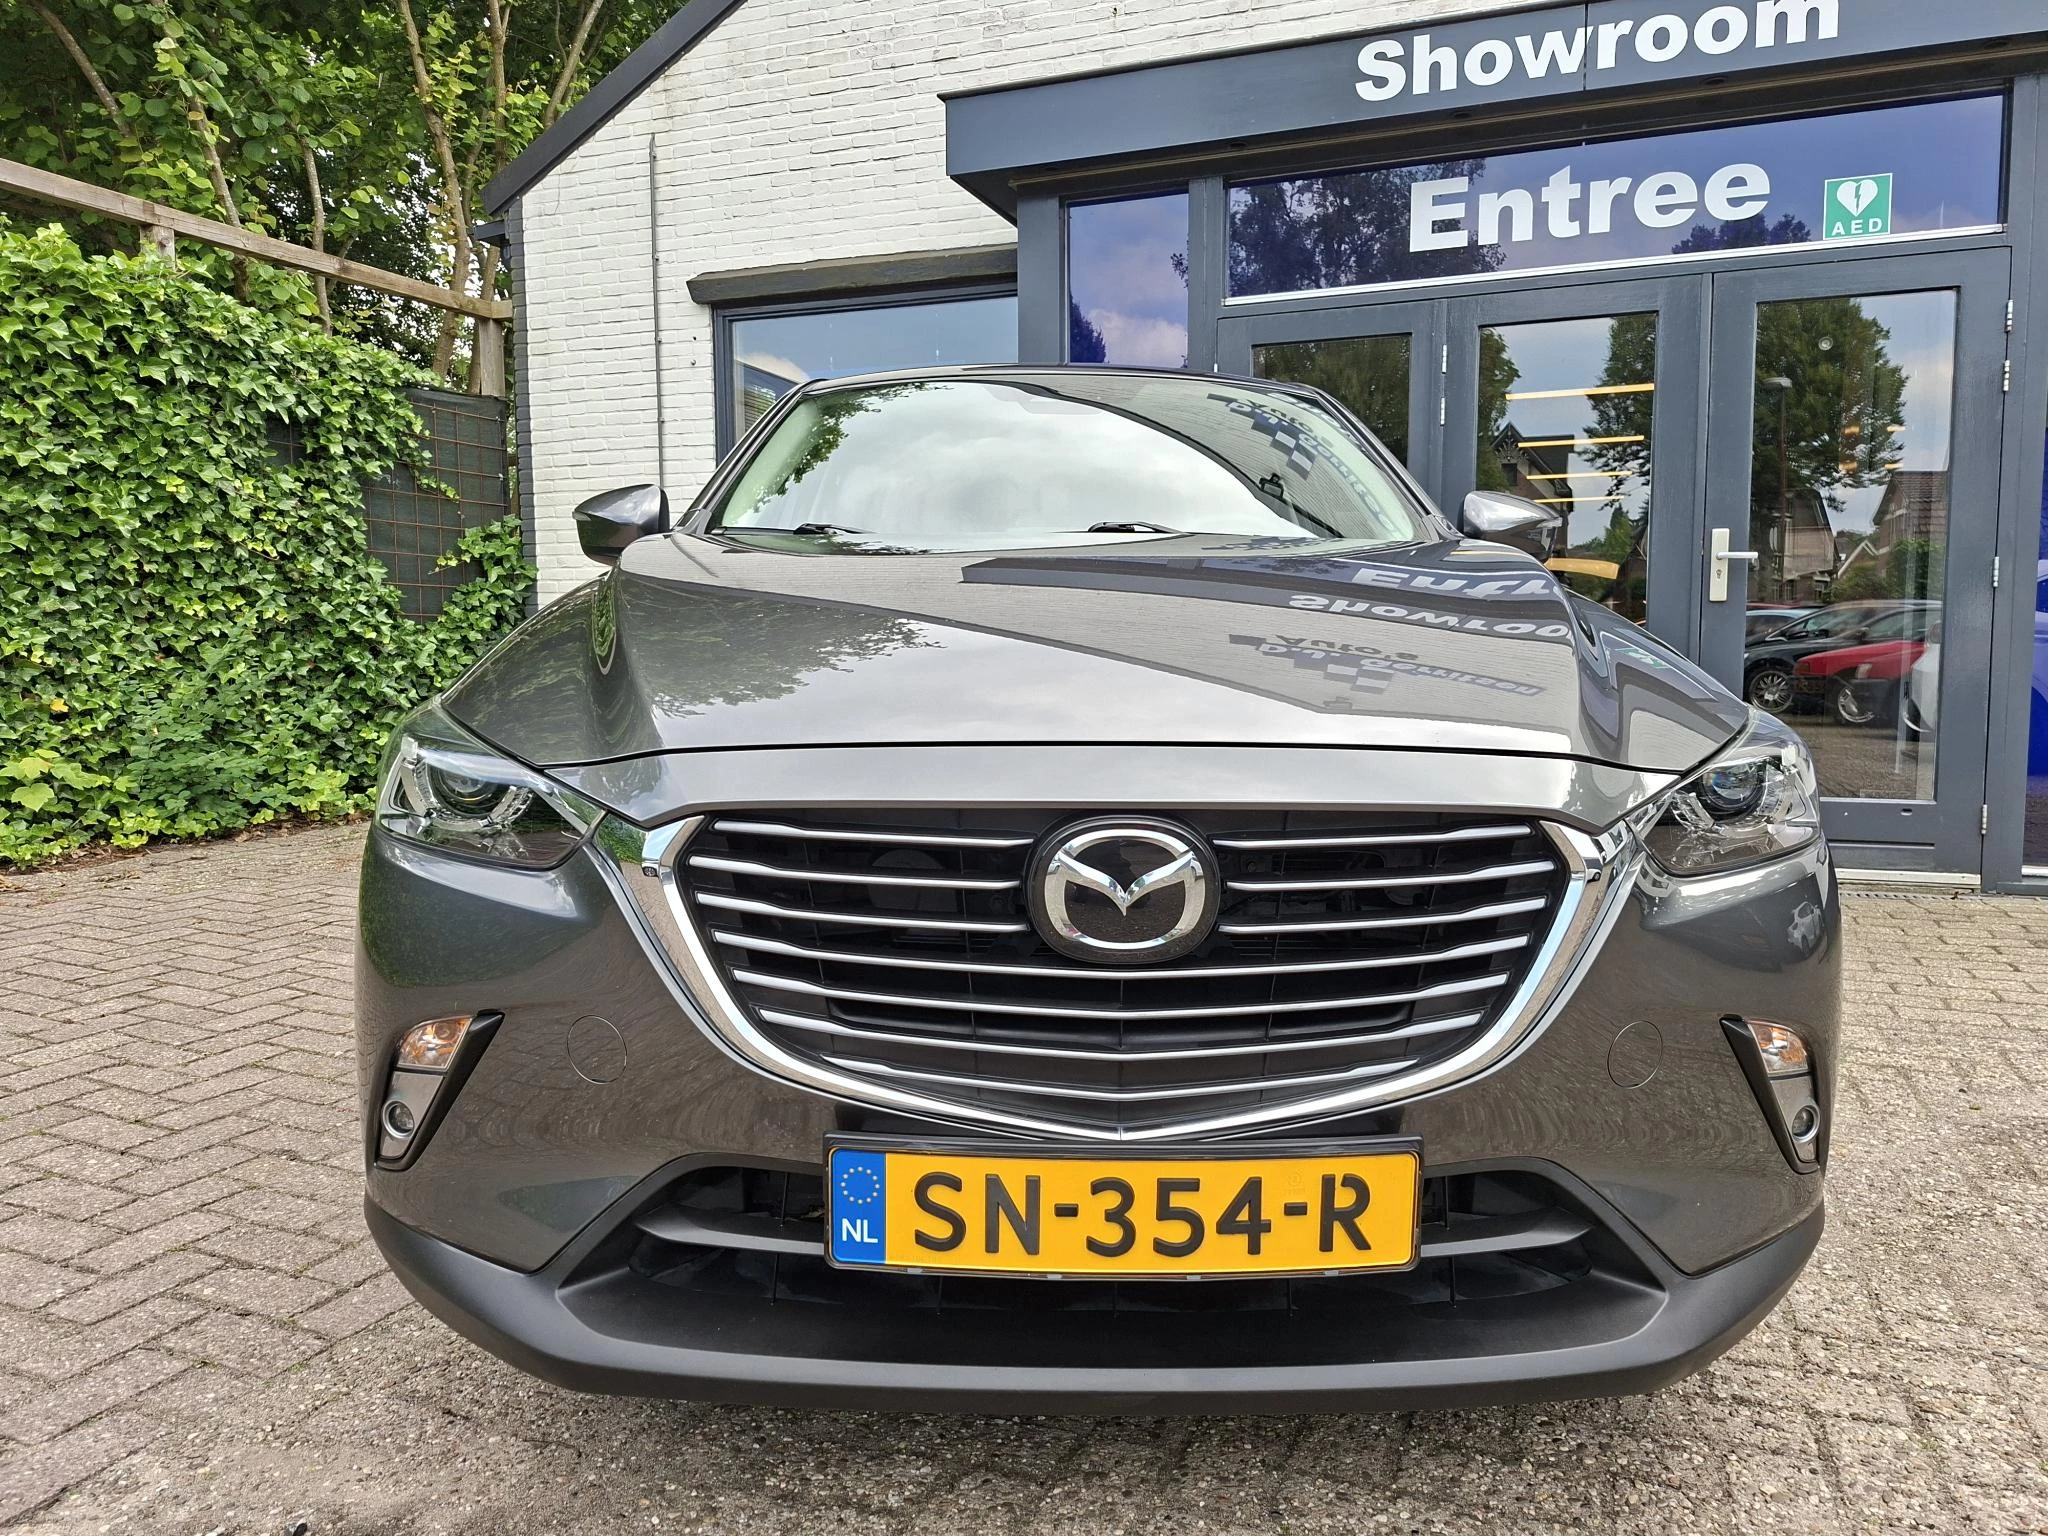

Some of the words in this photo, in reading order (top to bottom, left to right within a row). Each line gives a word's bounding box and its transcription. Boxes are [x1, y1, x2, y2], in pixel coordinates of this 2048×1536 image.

[1354, 0, 1839, 102] Showroom
[1409, 163, 1771, 253] Entree
[1831, 217, 1883, 237] AED
[840, 1217, 878, 1244] NL
[913, 1171, 1372, 1258] SN-354-R
